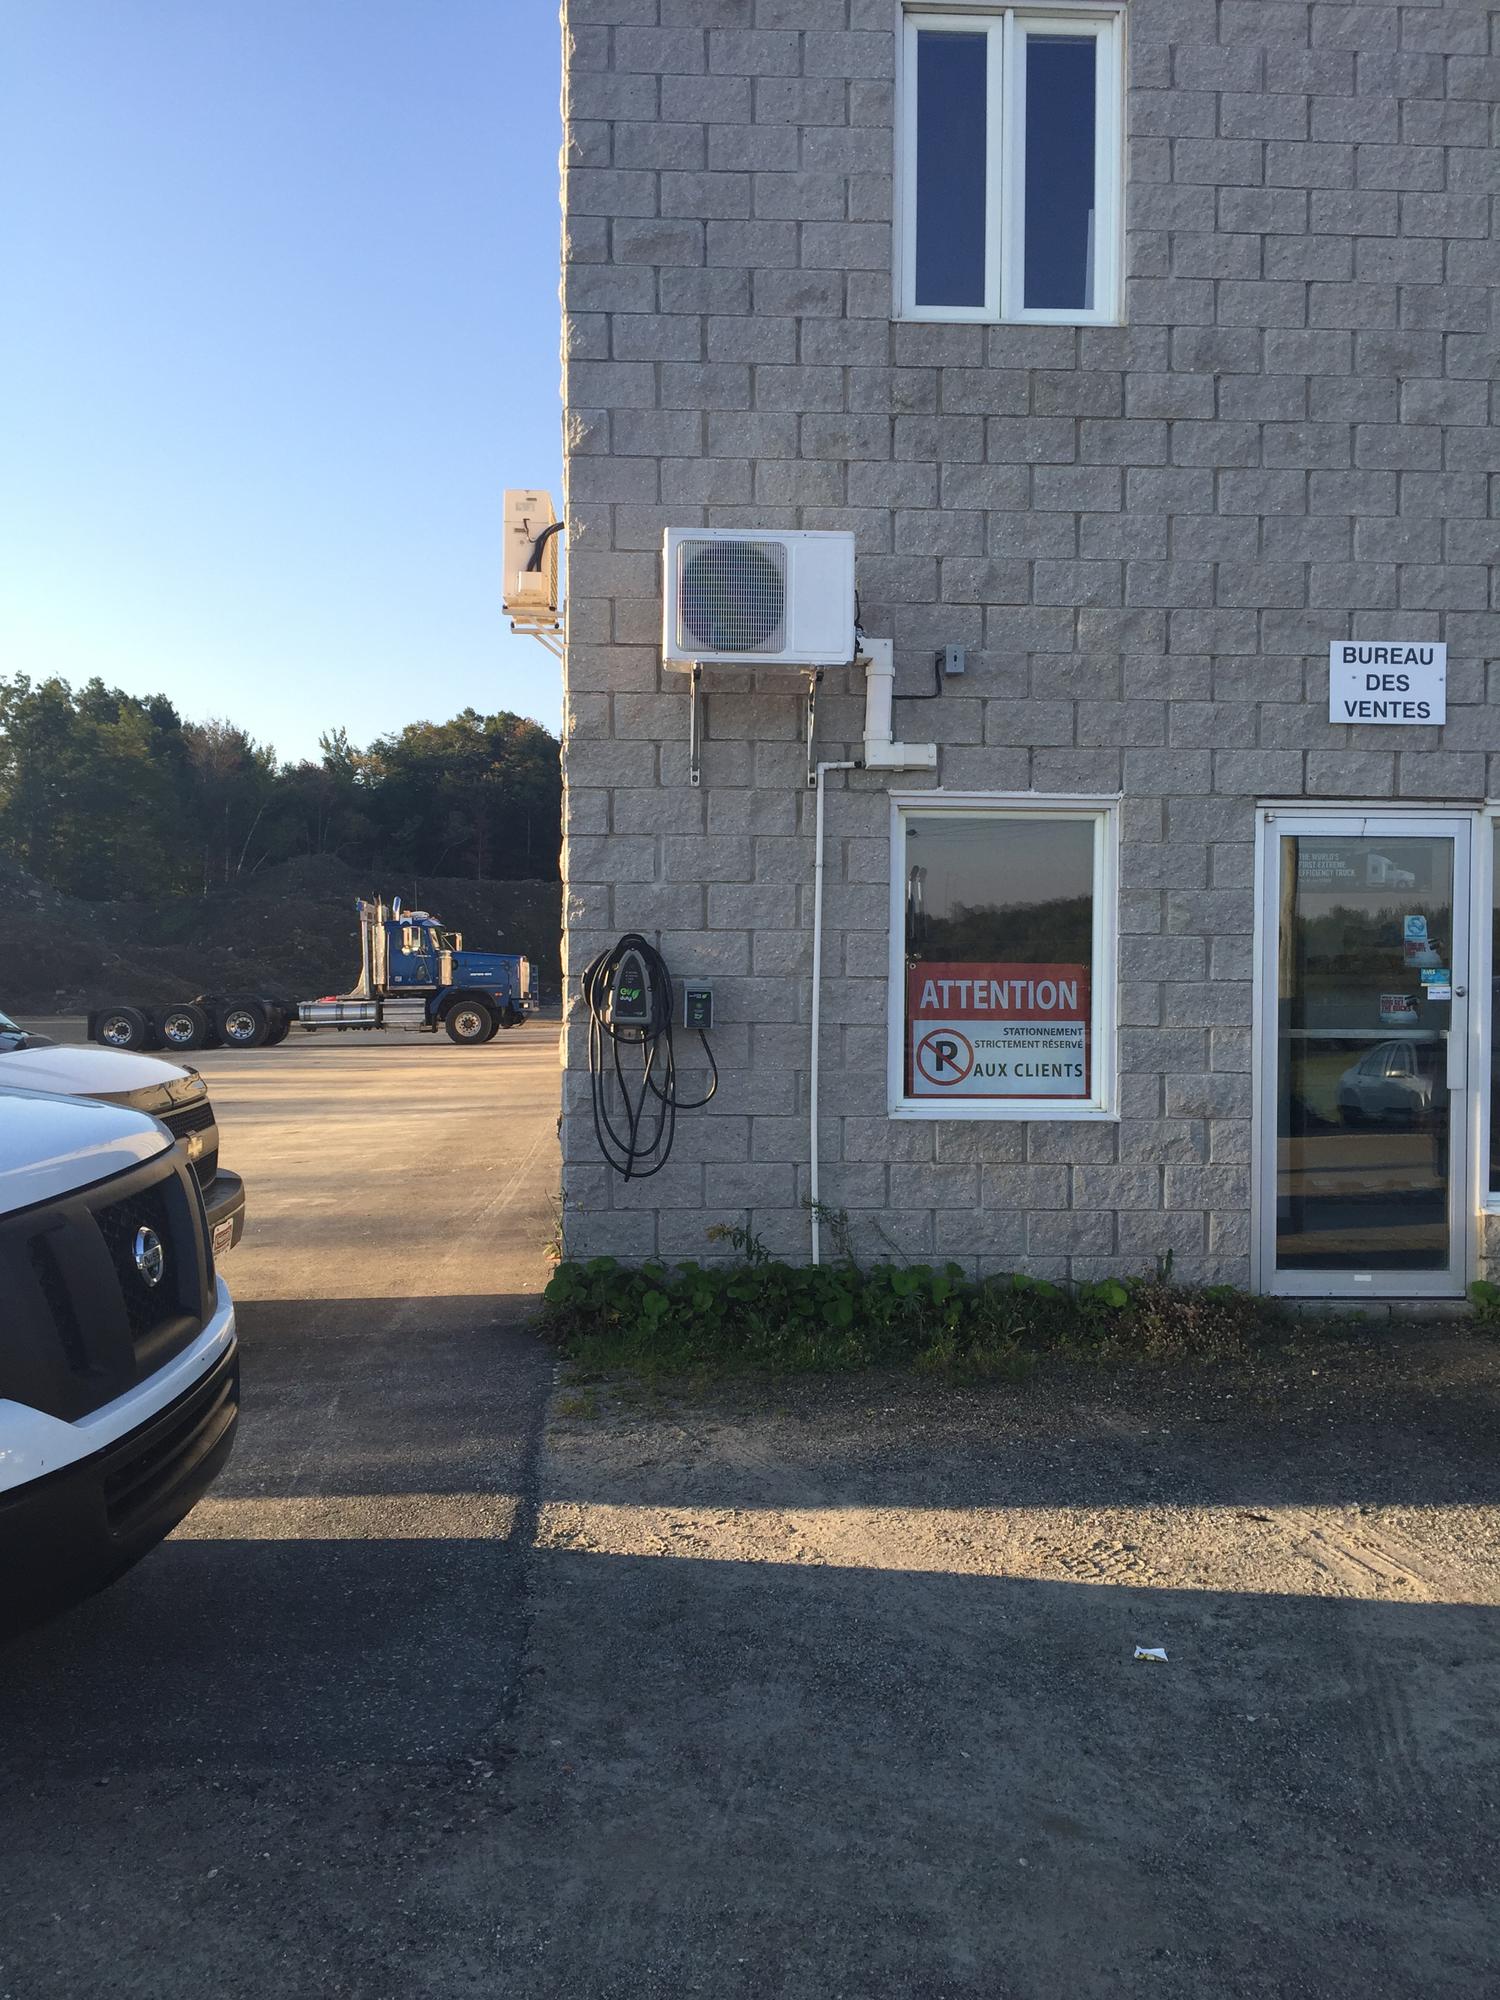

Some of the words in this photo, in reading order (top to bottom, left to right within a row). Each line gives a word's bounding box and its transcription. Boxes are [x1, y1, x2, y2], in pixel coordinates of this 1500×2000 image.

[1342, 646, 1434, 665] BUREAU
[1366, 674, 1410, 692] DES
[1344, 700, 1431, 719] VENTES
[920, 980, 1077, 1009] ATTENTION
[1003, 1027, 1083, 1036] STATIONNEMENT
[974, 1039, 1039, 1049] STRICTEMENT
[1042, 1038, 1084, 1049] RÉSERVÉ
[935, 1041, 958, 1071] P
[973, 1063, 1008, 1077] AUX
[1014, 1063, 1083, 1077] CLIENTS
